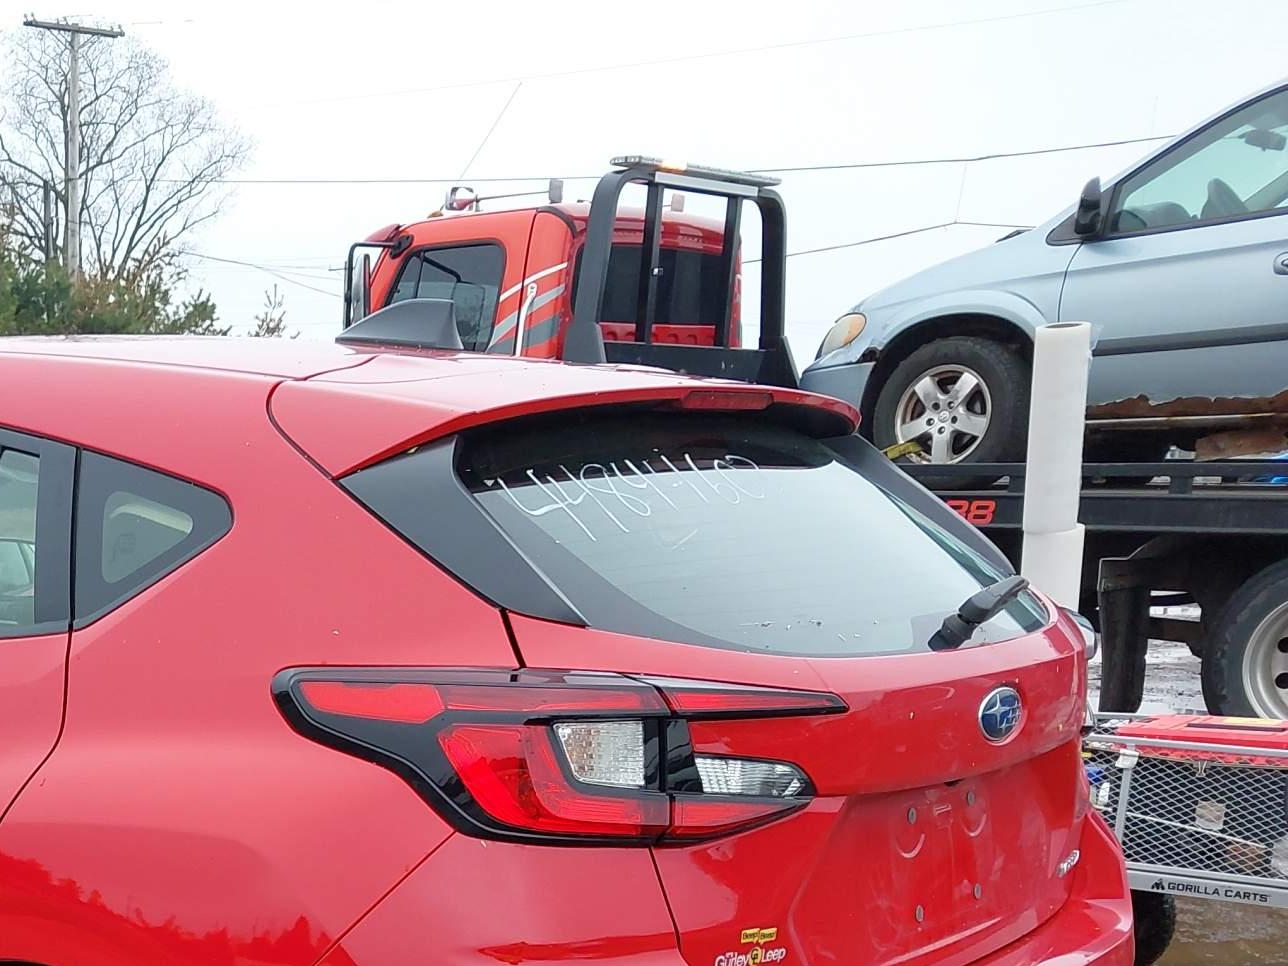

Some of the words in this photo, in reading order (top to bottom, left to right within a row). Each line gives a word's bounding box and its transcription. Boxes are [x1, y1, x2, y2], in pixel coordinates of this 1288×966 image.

[1168, 882, 1220, 896] GORILLA
[1225, 890, 1268, 902] CARTS
[762, 948, 786, 962] Leep
